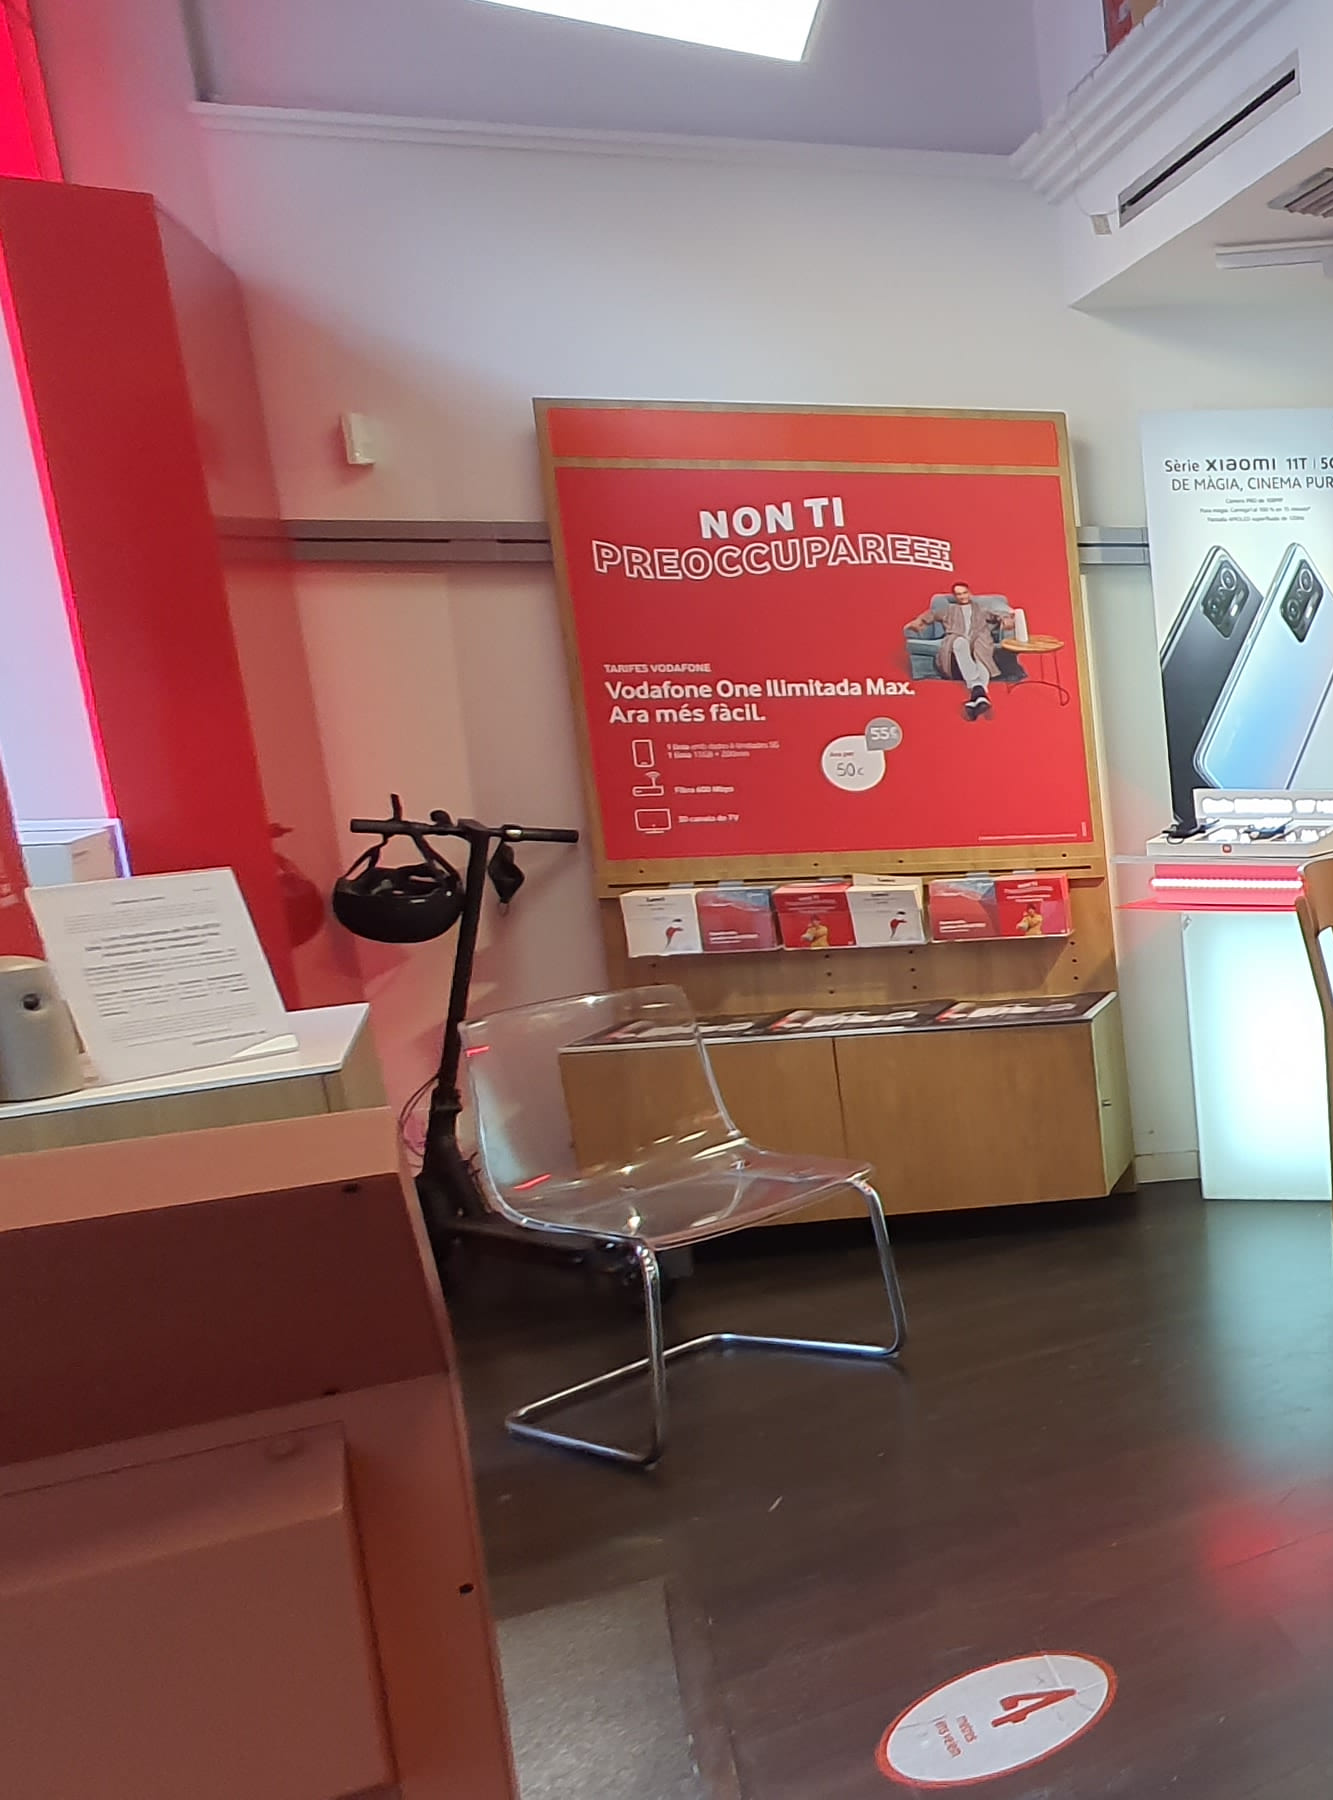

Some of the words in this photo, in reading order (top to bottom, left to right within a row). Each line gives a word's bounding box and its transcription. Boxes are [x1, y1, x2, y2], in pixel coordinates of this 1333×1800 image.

[1165, 459, 1200, 472] Sèrie
[1286, 457, 1308, 470] 11T
[1171, 478, 1189, 491] DE
[1194, 475, 1243, 492] MÀGIA,
[1247, 476, 1302, 490] CINEMA
[699, 501, 794, 539] NON
[804, 496, 846, 528] TI
[604, 663, 649, 674] TARIFES
[650, 663, 711, 673] VODAFONE
[605, 680, 713, 700] Vodafone
[716, 679, 762, 698] One
[766, 677, 862, 697] Ilimitada
[867, 678, 915, 697] Max.
[609, 705, 649, 724] Ara
[655, 704, 705, 722] més
[710, 703, 766, 722] fàcil.
[990, 1688, 1077, 1728] 4
